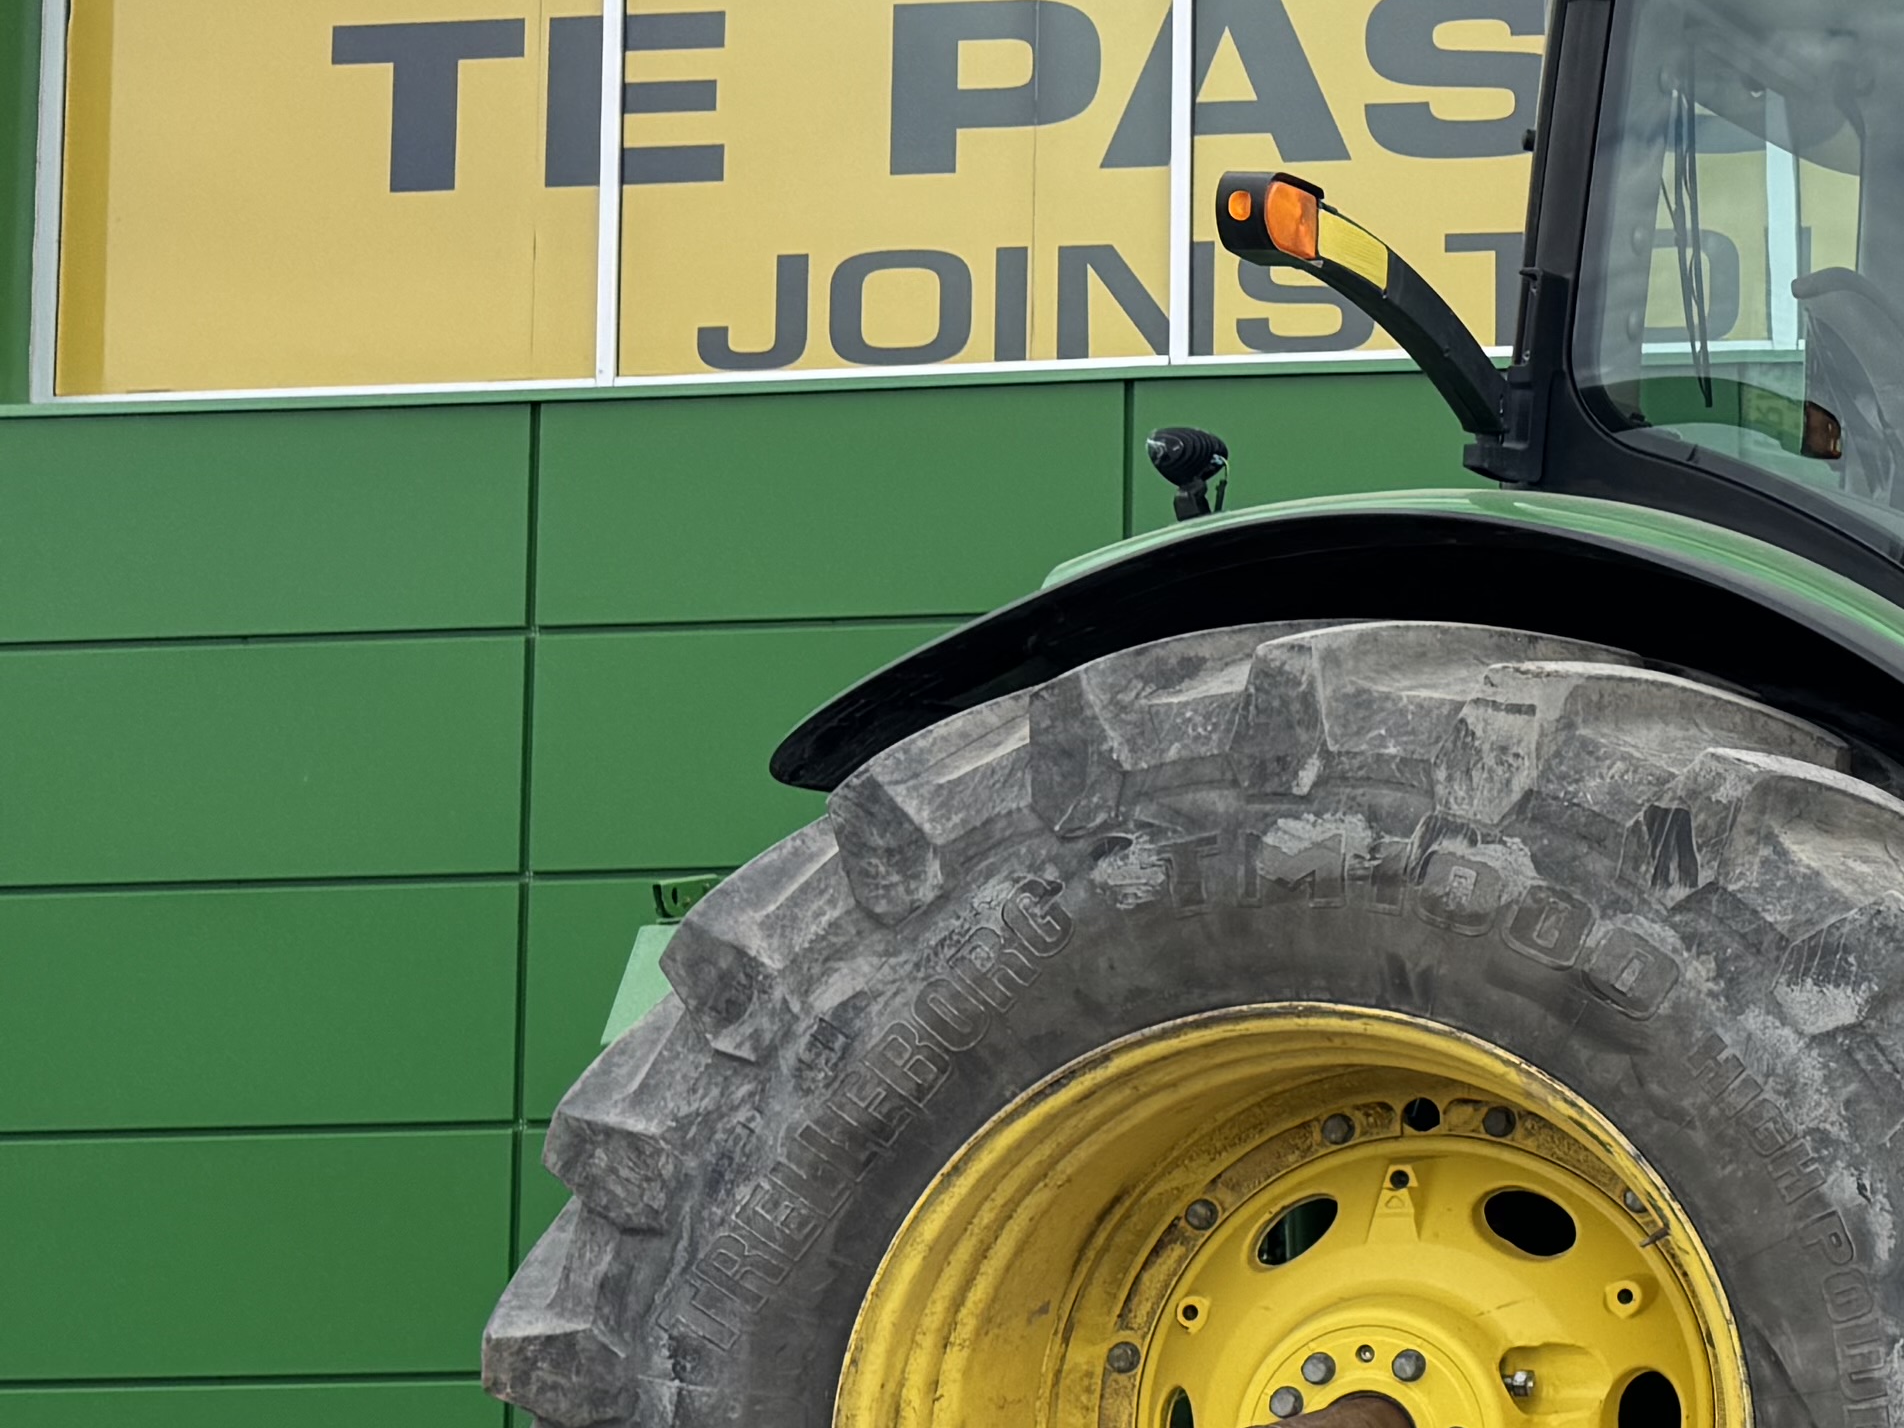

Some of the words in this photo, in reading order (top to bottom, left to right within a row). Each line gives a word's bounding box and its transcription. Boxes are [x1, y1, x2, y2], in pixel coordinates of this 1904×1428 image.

[331, 10, 726, 193] TE
[656, 877, 1076, 1353] TRELLEBORG
[1687, 1029, 1826, 1205] HIGH
